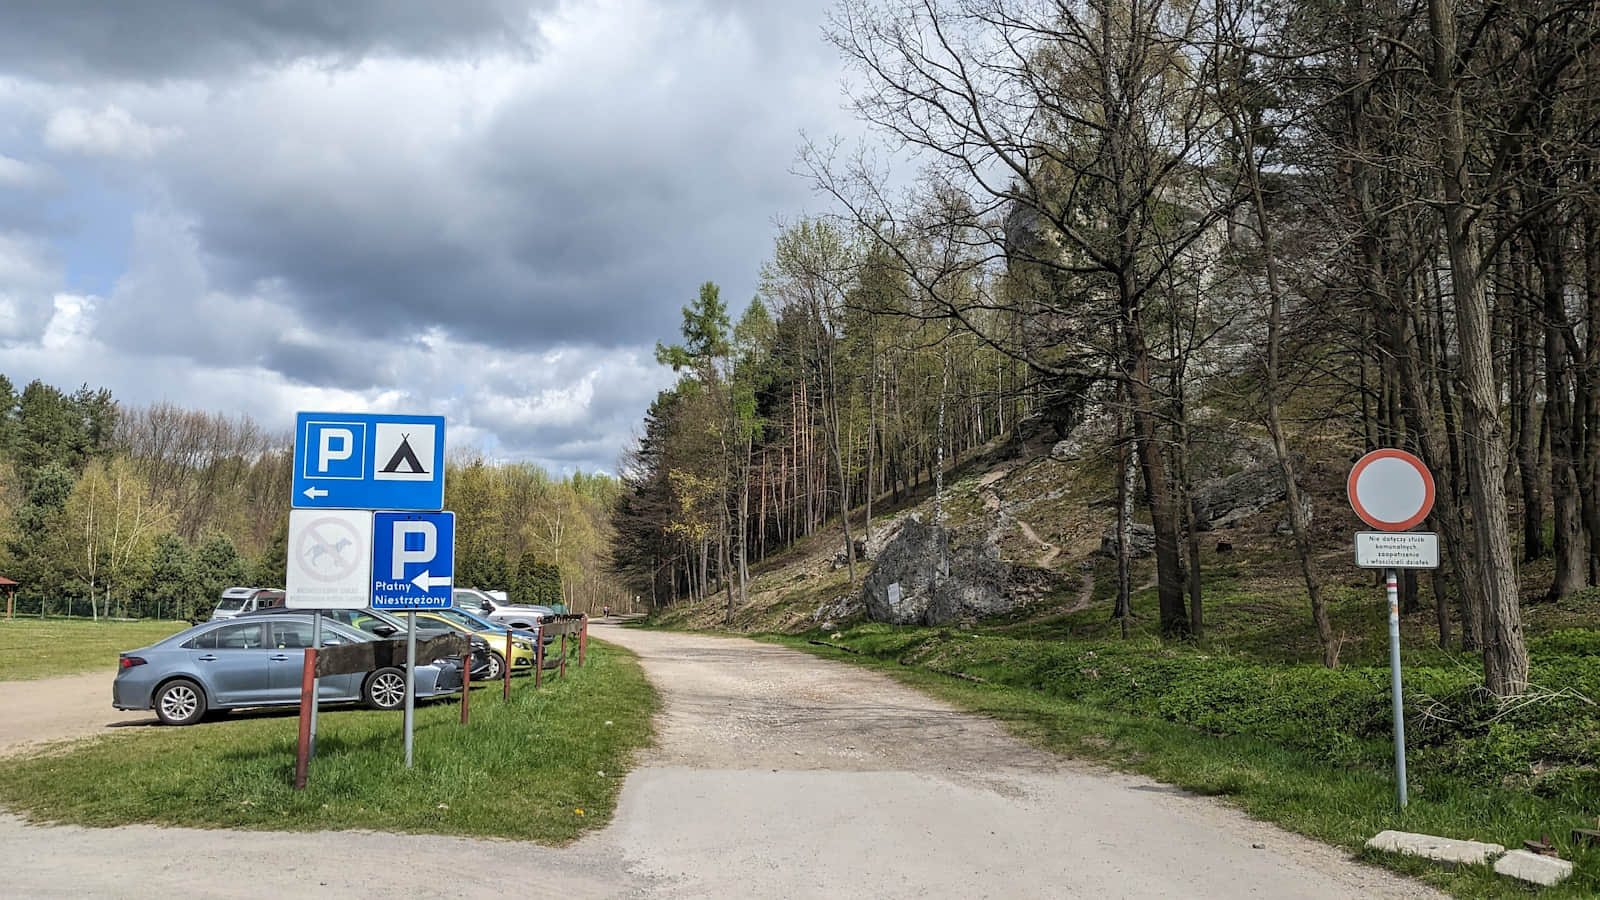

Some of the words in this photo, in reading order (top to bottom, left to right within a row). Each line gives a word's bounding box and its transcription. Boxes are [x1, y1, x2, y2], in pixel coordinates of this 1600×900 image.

[318, 428, 353, 472] P
[1382, 535, 1406, 543] dotyczy
[392, 521, 437, 579] P
[375, 581, 411, 593] Płatny
[375, 595, 446, 606] Niestrzeżony
